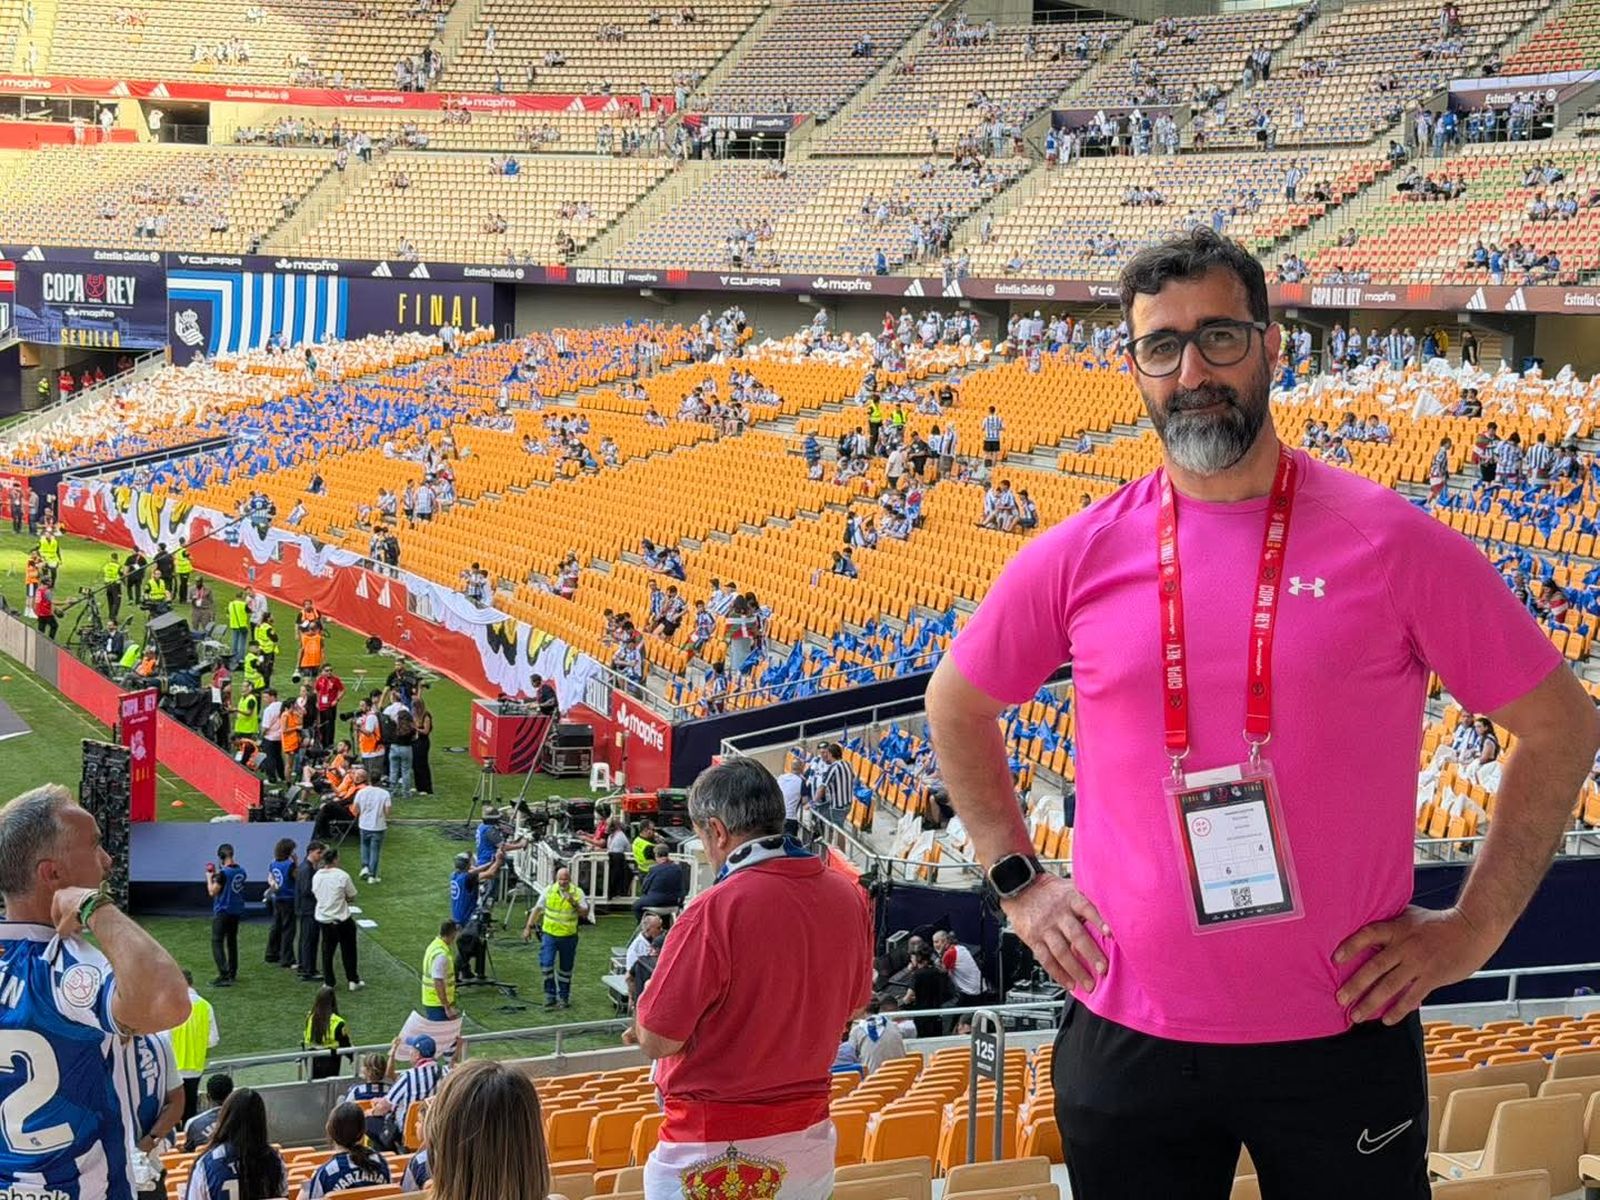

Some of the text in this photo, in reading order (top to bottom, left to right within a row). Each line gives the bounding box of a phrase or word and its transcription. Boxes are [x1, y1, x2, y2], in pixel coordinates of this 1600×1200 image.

[3, 79, 51, 90] mapfre
[473, 97, 516, 108] mapfre
[93, 250, 150, 262] Estrella Galicia
[188, 256, 242, 266] CUPRA
[293, 260, 339, 272] mapfre
[463, 267, 515, 279] Estrella Galicia
[576, 269, 657, 284] COPA DEL REY mapfre
[729, 277, 780, 286] CUPRA
[43, 272, 85, 303] COPA
[105, 275, 136, 304] REY
[829, 278, 872, 292] mapfre
[995, 283, 1045, 296] Estrella Galicia
[1311, 287, 1396, 305] COPA DEL REY mapfre
[1564, 292, 1595, 306] Estrella
[79, 308, 115, 319] mapfre
[399, 293, 479, 328] FINAL
[60, 327, 121, 348] SEVILLA
[1257, 584, 1275, 606] COPA
[1254, 612, 1271, 630] REY
[1166, 643, 1181, 660] REY
[1167, 666, 1183, 690] COPA
[629, 713, 664, 752] mapfre
[1258, 844, 1264, 852] 4
[1226, 866, 1232, 875] 6
[974, 1038, 995, 1062] 125
